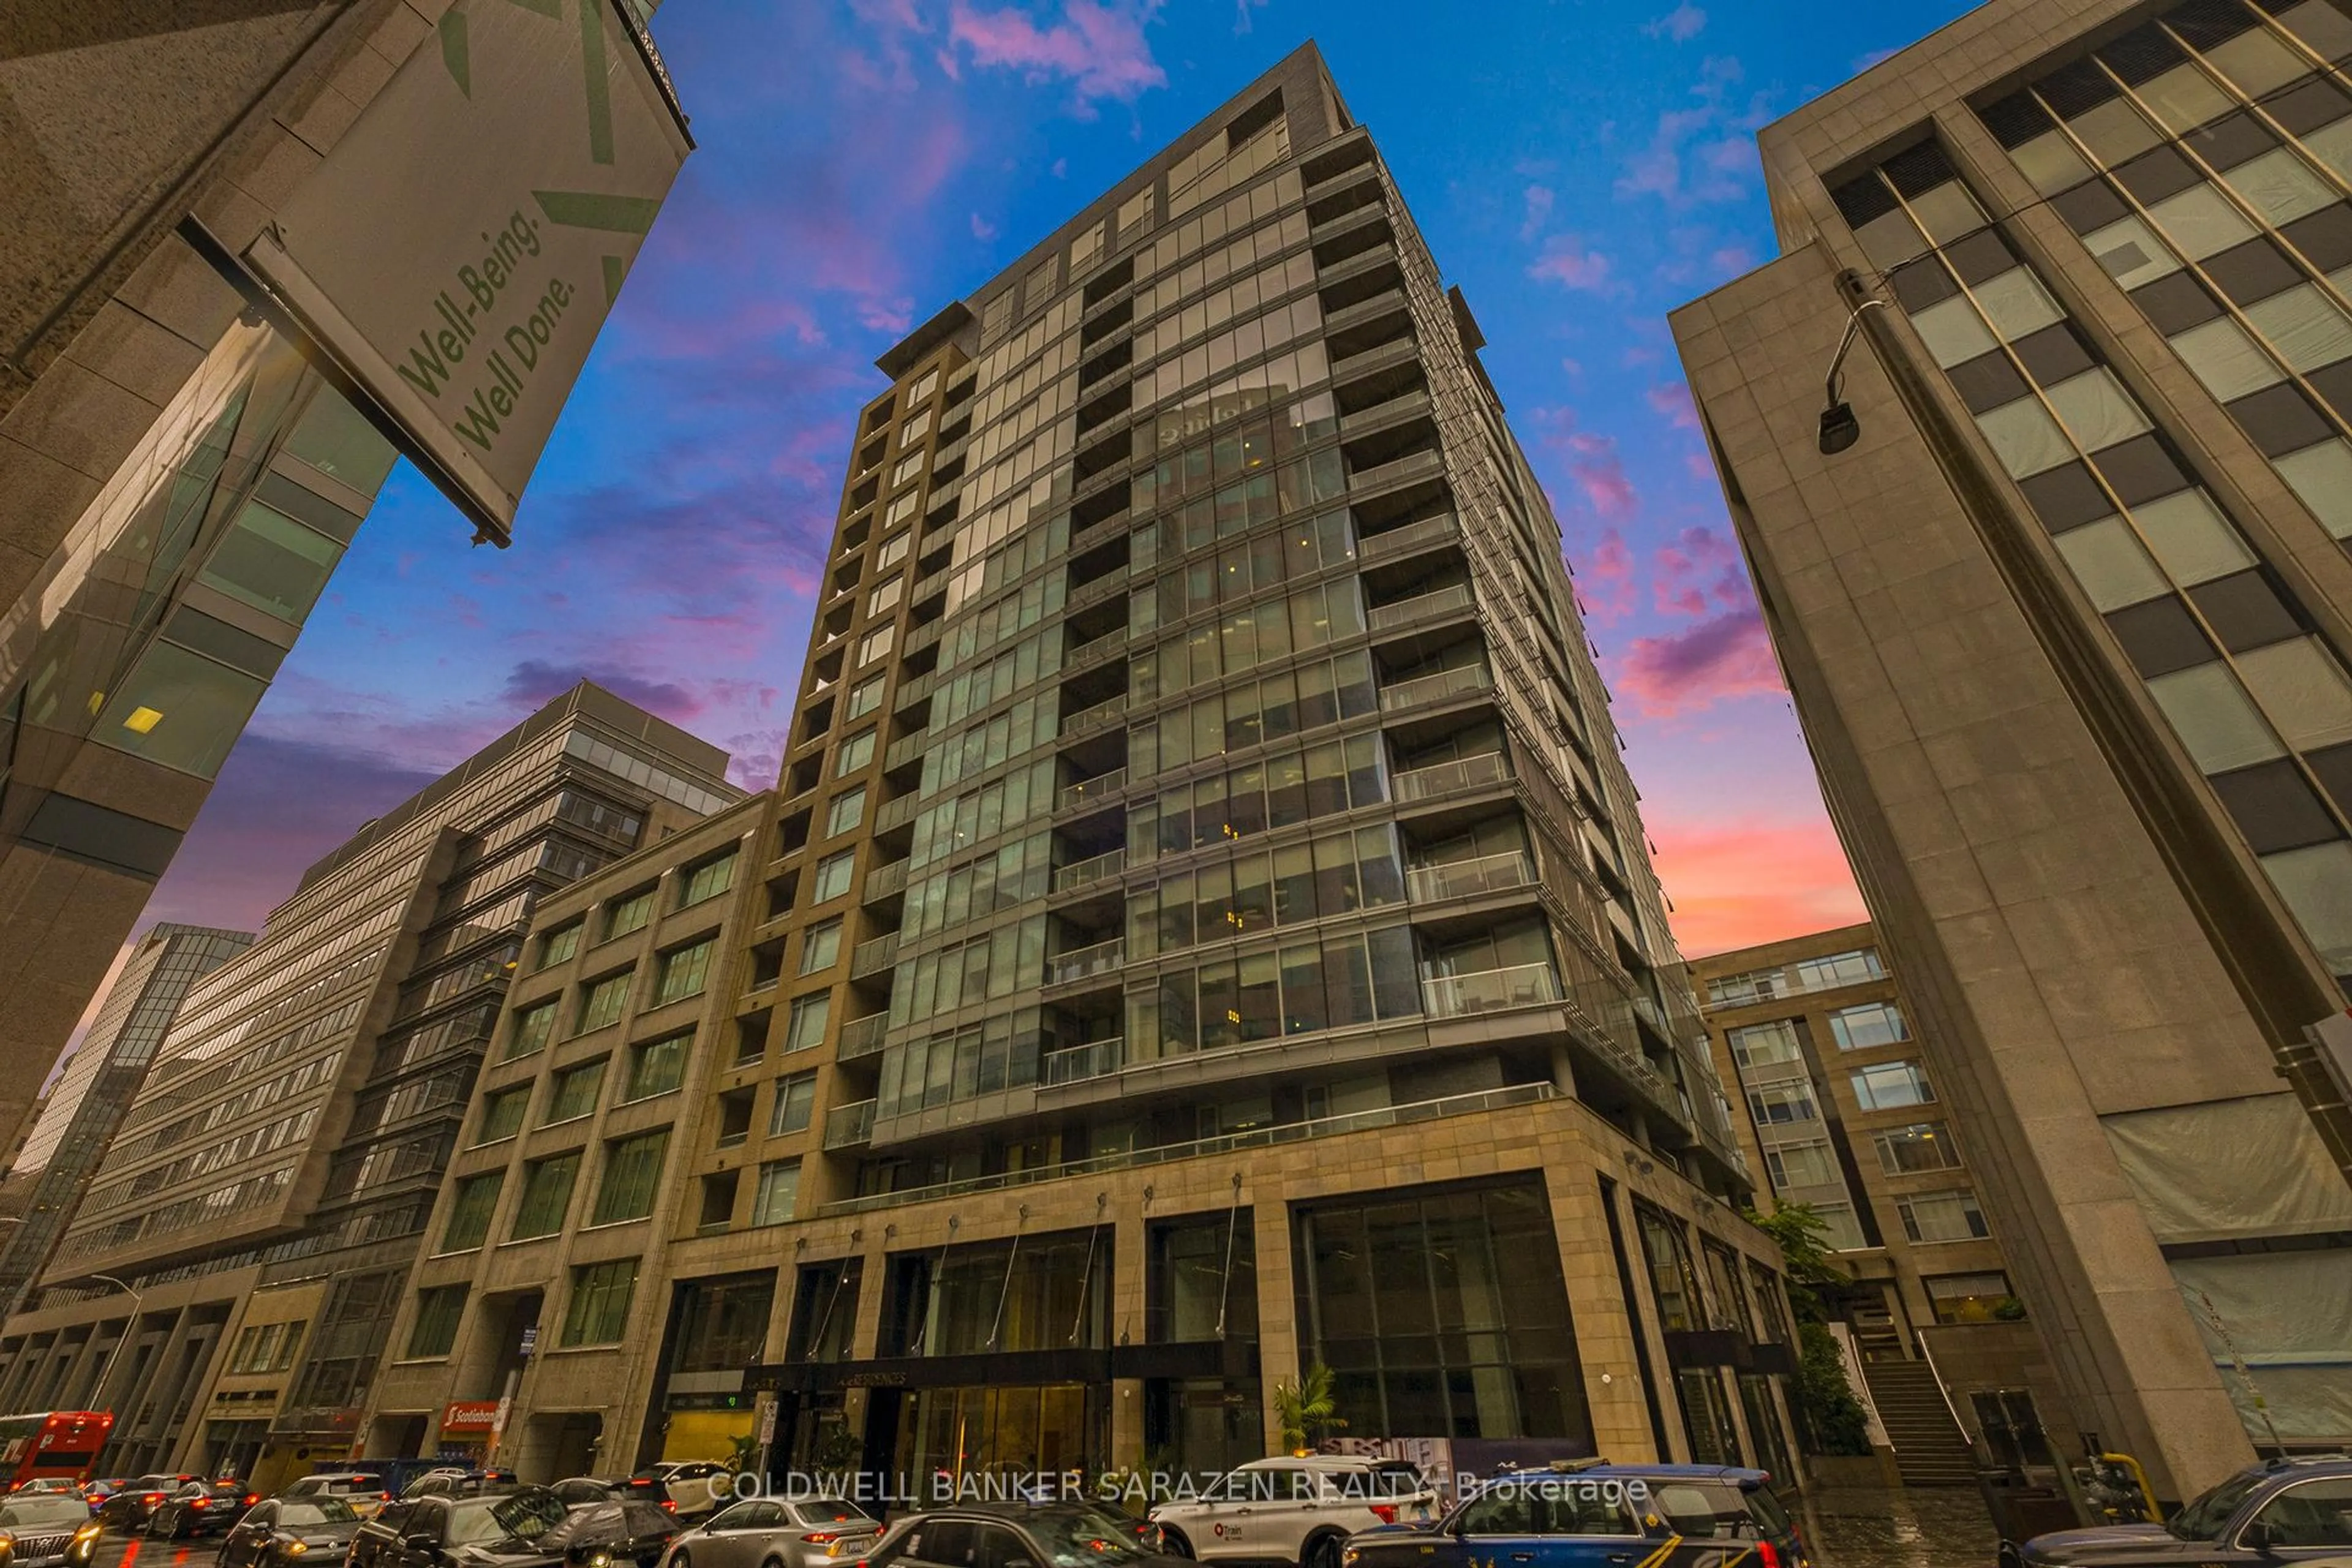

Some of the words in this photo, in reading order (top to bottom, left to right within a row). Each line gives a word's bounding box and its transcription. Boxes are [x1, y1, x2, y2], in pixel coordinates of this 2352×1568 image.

[398, 210, 542, 399] Well-Being.
[454, 349, 525, 452] Well
[504, 276, 576, 373] Done.
[454, 1408, 494, 1423] Scotiaban
